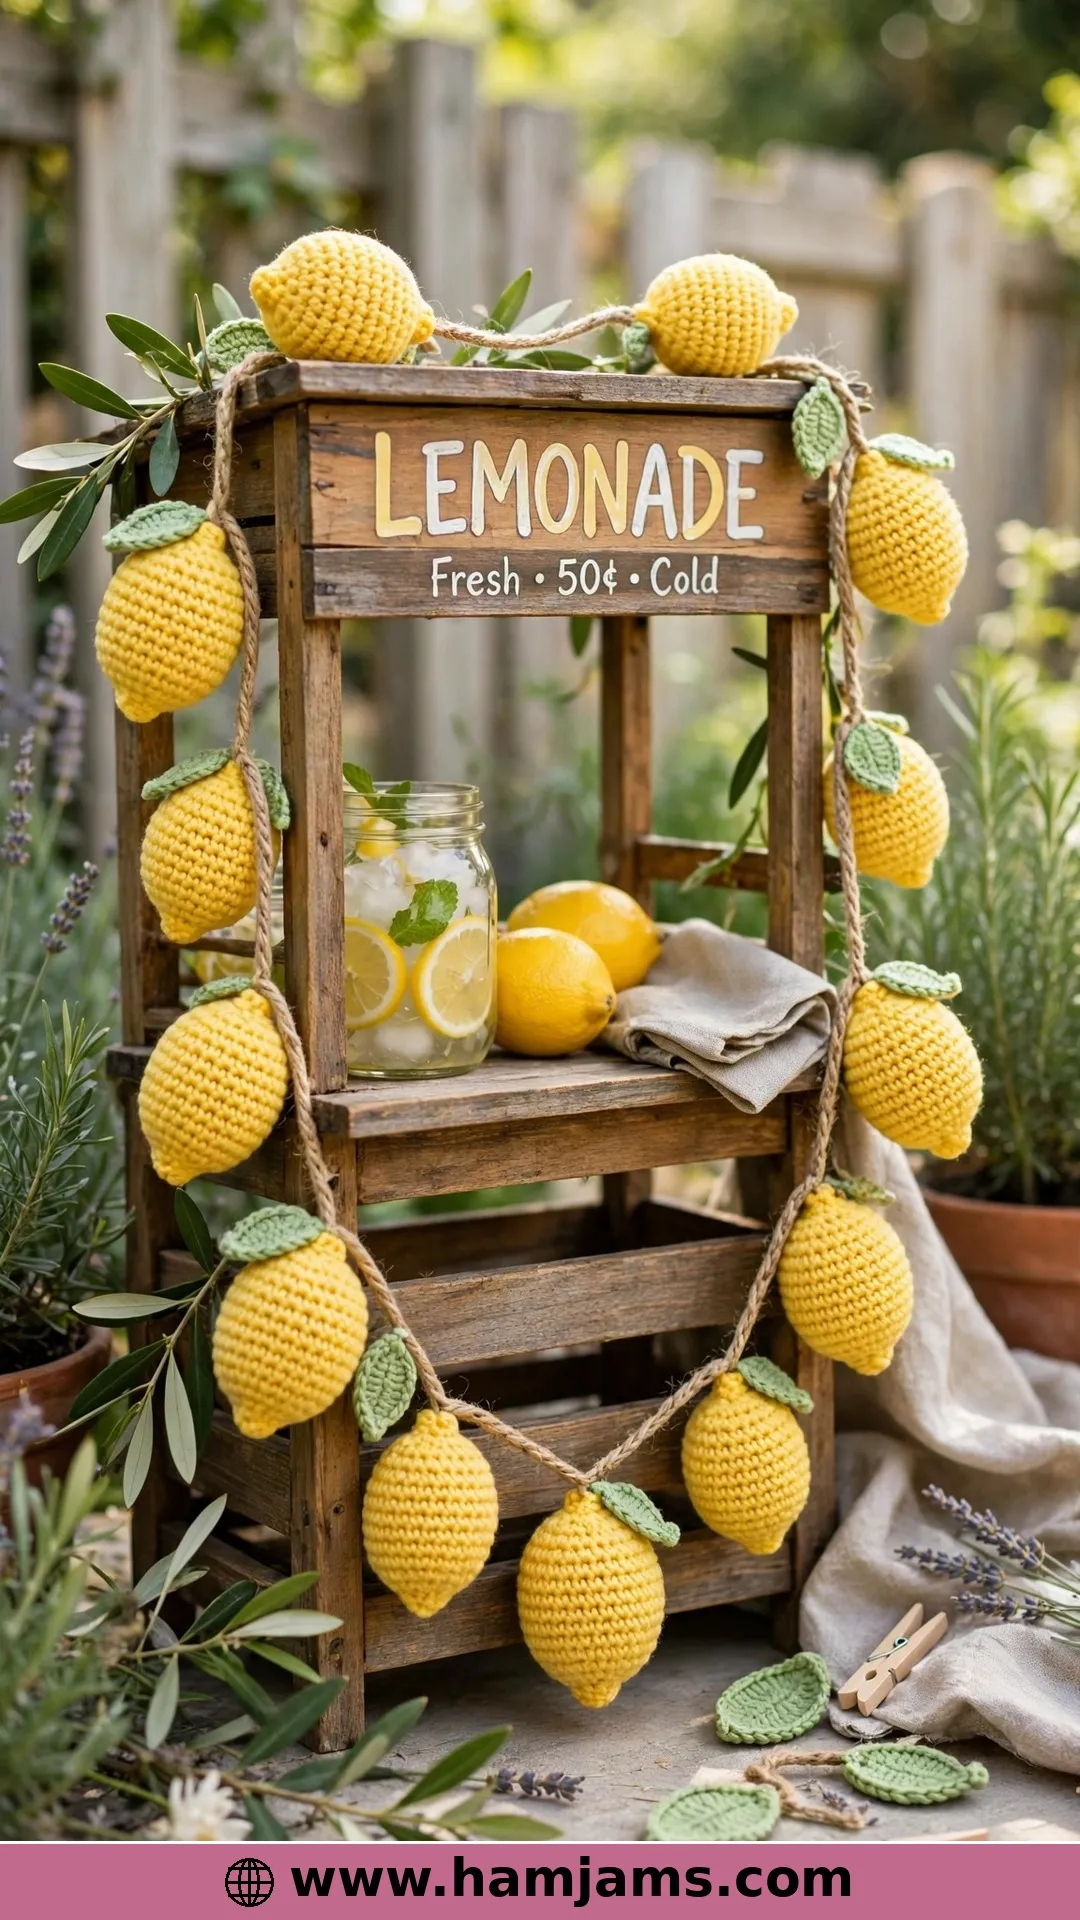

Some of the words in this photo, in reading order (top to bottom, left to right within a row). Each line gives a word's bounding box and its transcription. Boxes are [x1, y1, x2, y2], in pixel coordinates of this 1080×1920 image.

[374, 430, 765, 540] LEMONADE
[431, 555, 520, 598] Fresh
[557, 557, 619, 597] 50¢
[650, 555, 720, 597] Cold
